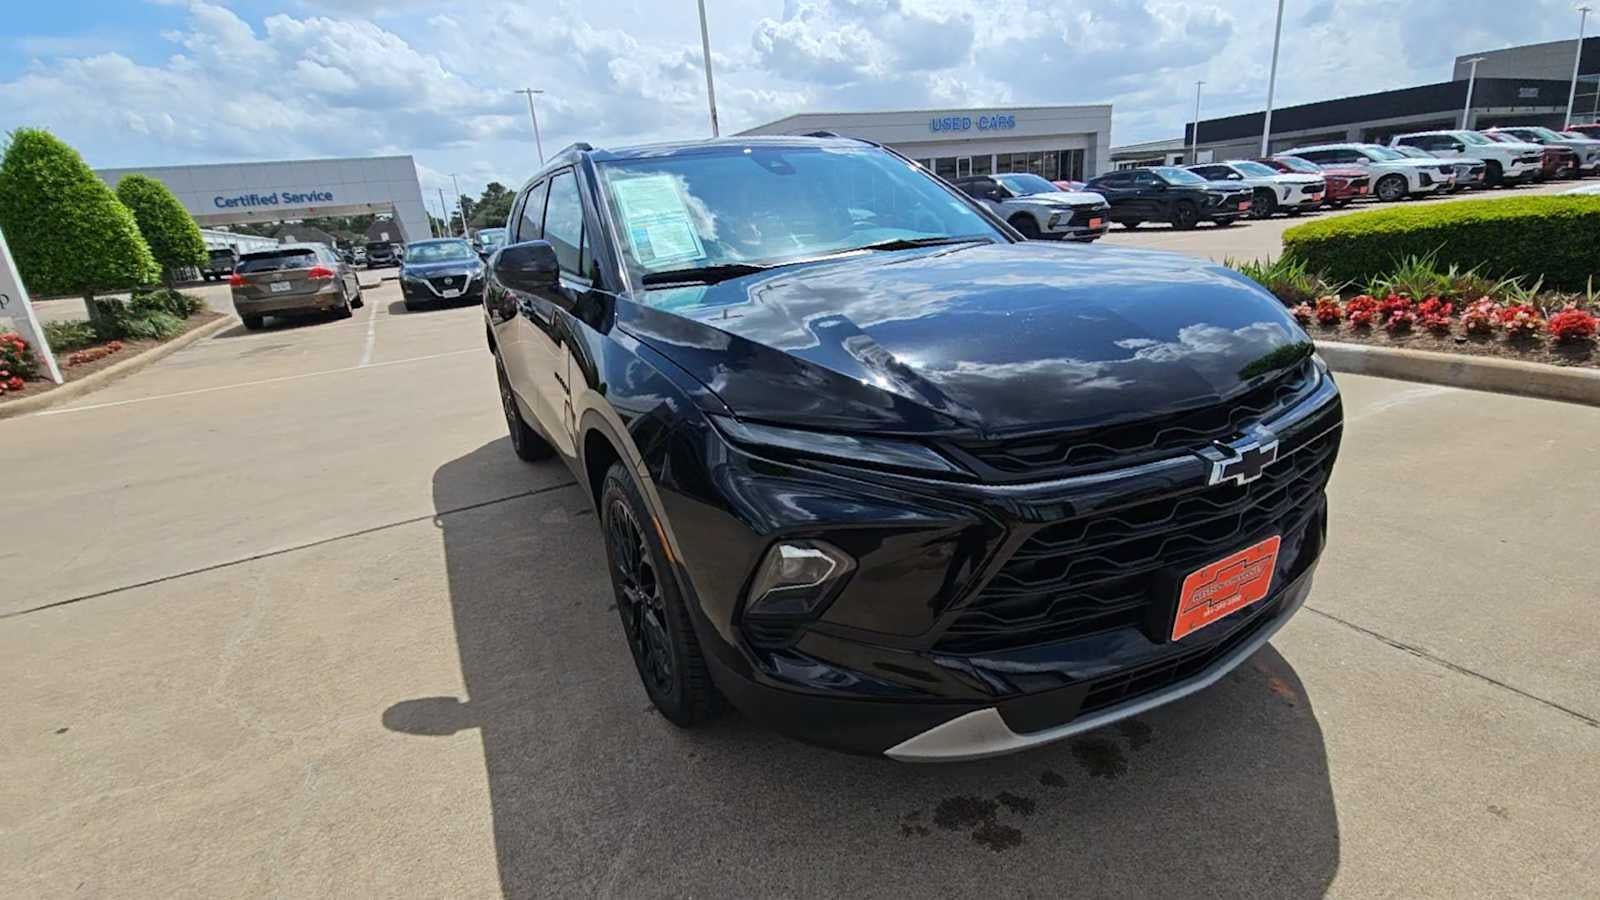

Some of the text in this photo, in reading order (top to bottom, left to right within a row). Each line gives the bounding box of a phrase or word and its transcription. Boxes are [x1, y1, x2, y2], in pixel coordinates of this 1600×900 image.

[930, 115, 1016, 131] USED CARS
[214, 190, 333, 208] Certified Service
